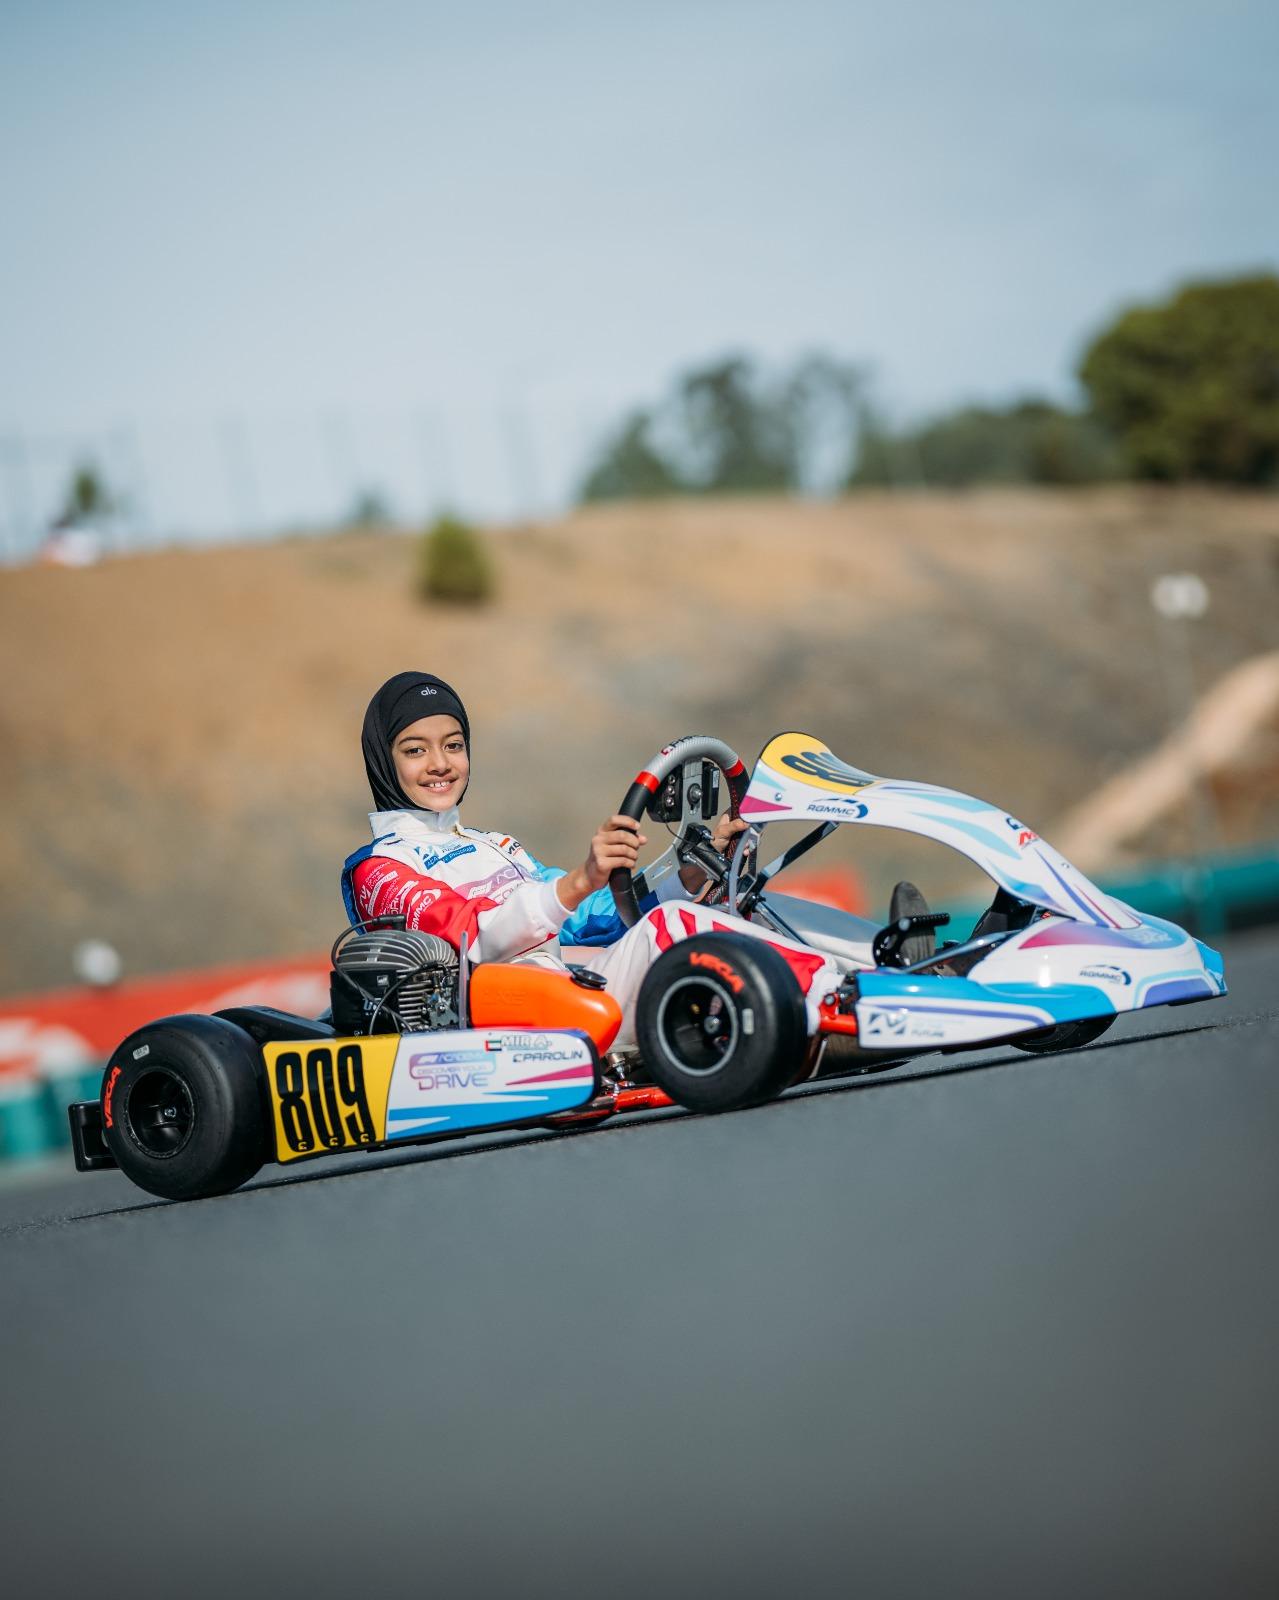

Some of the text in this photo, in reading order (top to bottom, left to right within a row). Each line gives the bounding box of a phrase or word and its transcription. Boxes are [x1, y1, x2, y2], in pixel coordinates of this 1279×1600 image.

[420, 686, 437, 695] alo
[411, 894, 432, 930] GMMC
[104, 1066, 122, 1129] VEGA
[275, 1044, 377, 1153] 809
[418, 1072, 488, 1091] DRIVE
